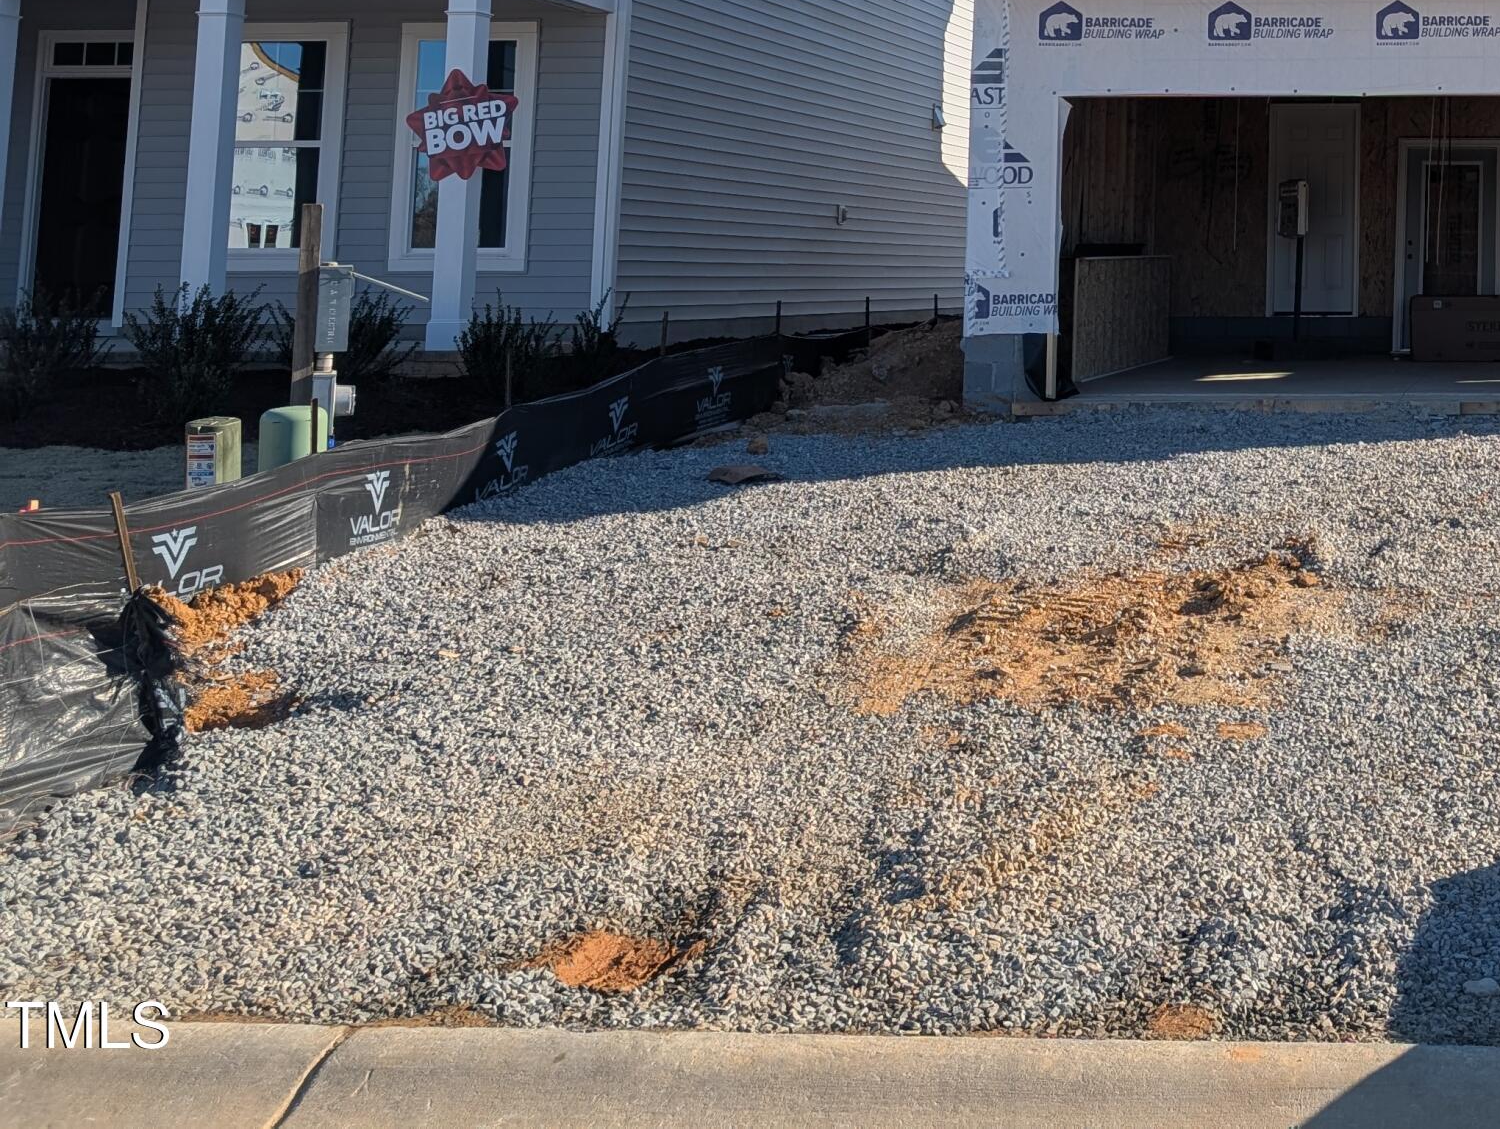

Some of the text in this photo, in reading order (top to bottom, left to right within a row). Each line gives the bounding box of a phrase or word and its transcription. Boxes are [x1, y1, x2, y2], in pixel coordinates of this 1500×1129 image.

[1085, 17, 1154, 28] BARRICADE
[1254, 16, 1323, 27] BARRICADE
[1422, 15, 1490, 27] BARRICADE
[1084, 28, 1165, 39] BUILDING WRAP
[1253, 27, 1334, 39] BUILDING WRAP
[1421, 26, 1470, 37] BUILDING
[423, 99, 507, 129] BIG RED
[425, 116, 505, 156] BOW
[991, 305, 1041, 317] BUILDING
[697, 391, 732, 416] VALOR
[589, 422, 639, 457] VALOR
[475, 465, 529, 500] VALOR
[350, 508, 401, 536] VALOR
